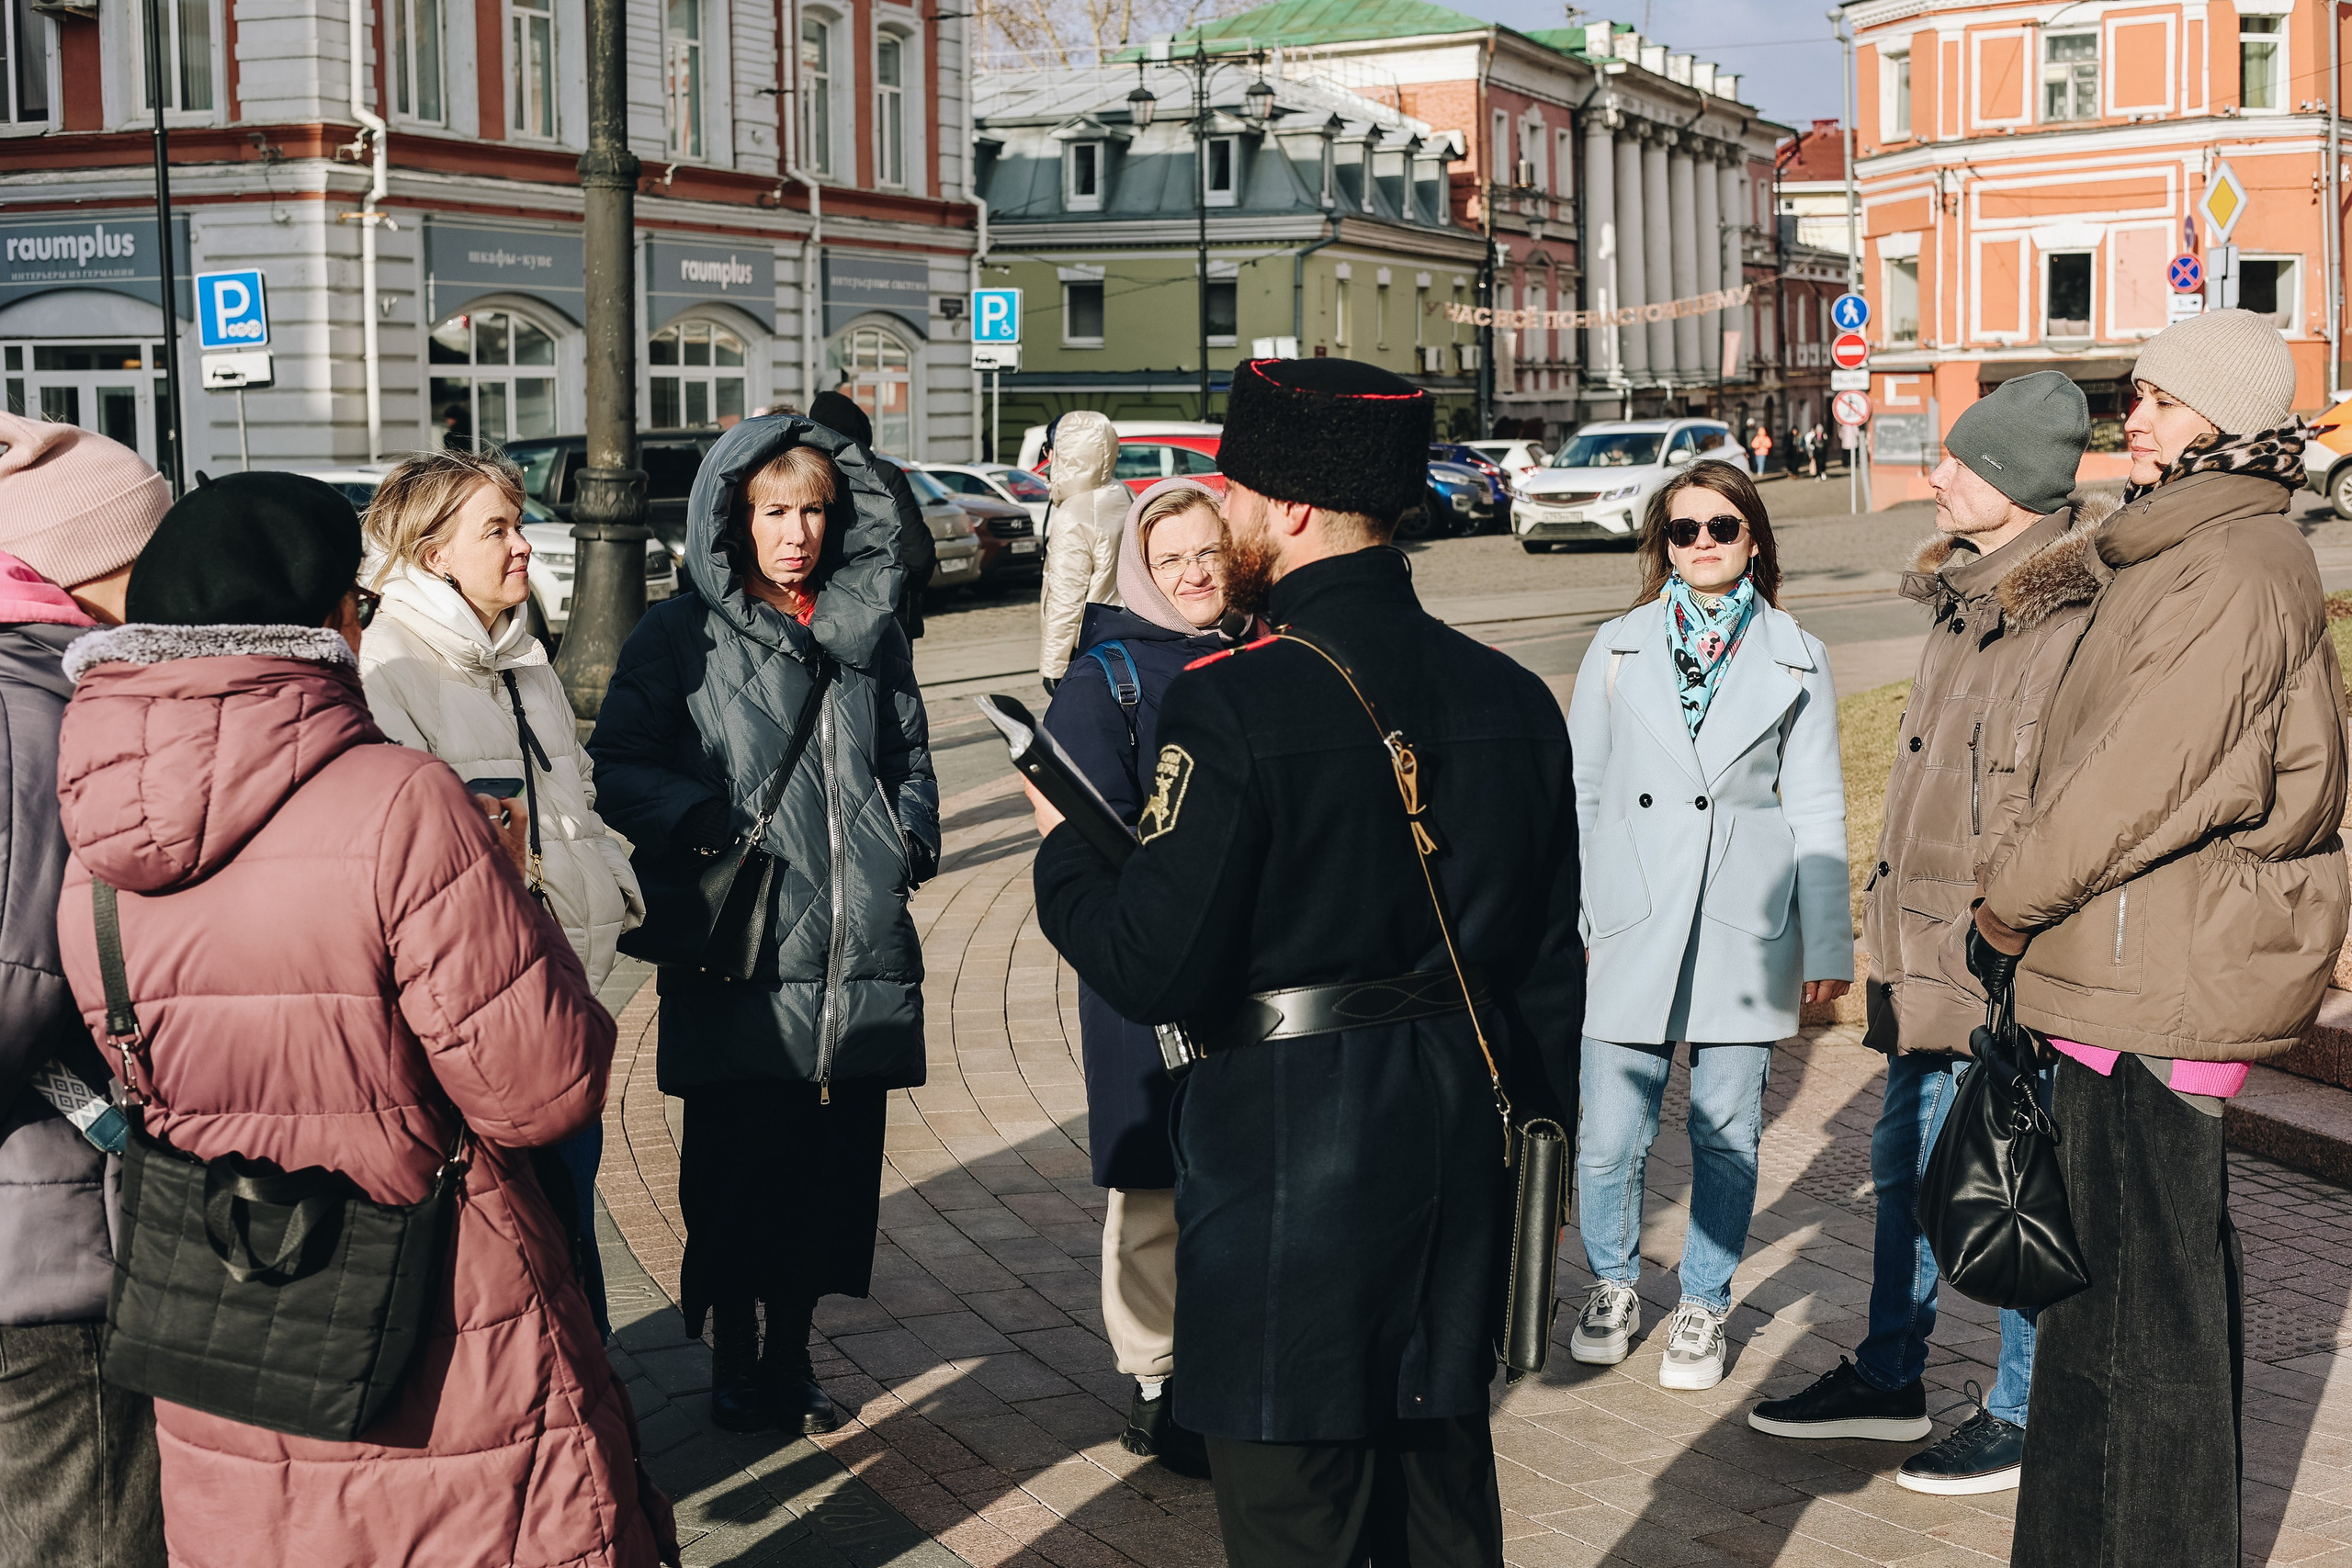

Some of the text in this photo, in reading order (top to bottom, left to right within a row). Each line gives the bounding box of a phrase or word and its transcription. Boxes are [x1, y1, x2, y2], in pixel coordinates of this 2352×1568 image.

[6, 223, 135, 268] raumplus
[468, 247, 553, 271] шкафы-купе
[11, 271, 66, 280] ИНТЕРЬЕРЫ
[680, 254, 753, 291] raumplus
[213, 279, 251, 340] P
[981, 295, 1009, 337] P
[1442, 300, 1493, 327] НАС
